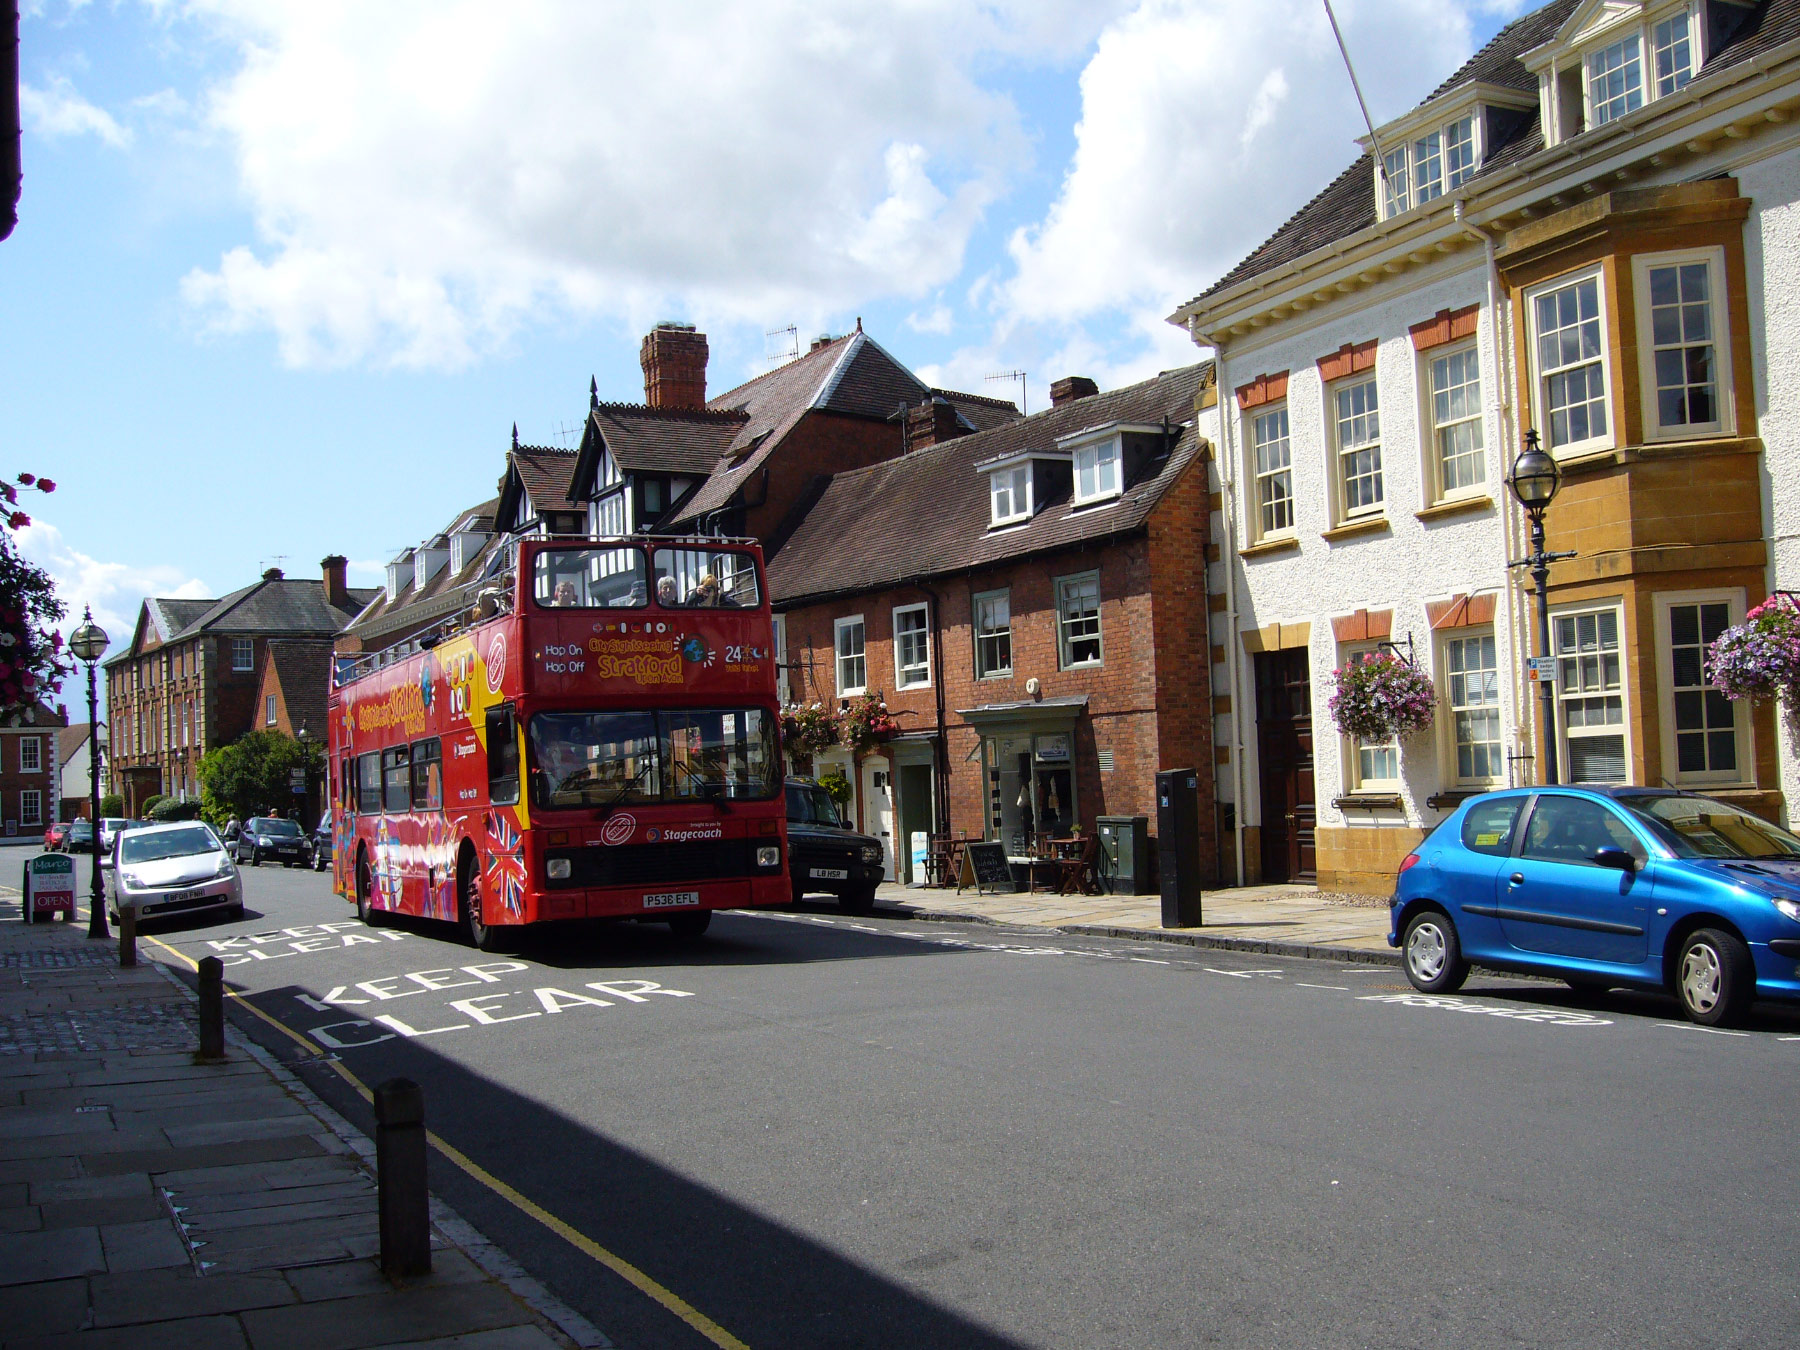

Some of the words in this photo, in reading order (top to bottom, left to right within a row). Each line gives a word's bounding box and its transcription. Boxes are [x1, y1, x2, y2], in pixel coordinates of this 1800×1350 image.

[545, 645, 566, 657] Hop
[568, 644, 583, 656] On
[725, 645, 742, 663] 24
[545, 662, 566, 673] Hop
[569, 661, 585, 673] Off
[598, 653, 683, 679] Stratford
[635, 674, 661, 685] Upon
[663, 828, 722, 842] Stagecoach
[35, 860, 71, 870] Marco
[37, 896, 70, 907] OPEN
[647, 894, 674, 906] P536
[676, 893, 696, 904] EFL
[207, 921, 363, 952] KEEP
[296, 961, 529, 1012] KEEP
[308, 979, 695, 1049] CLEAR
